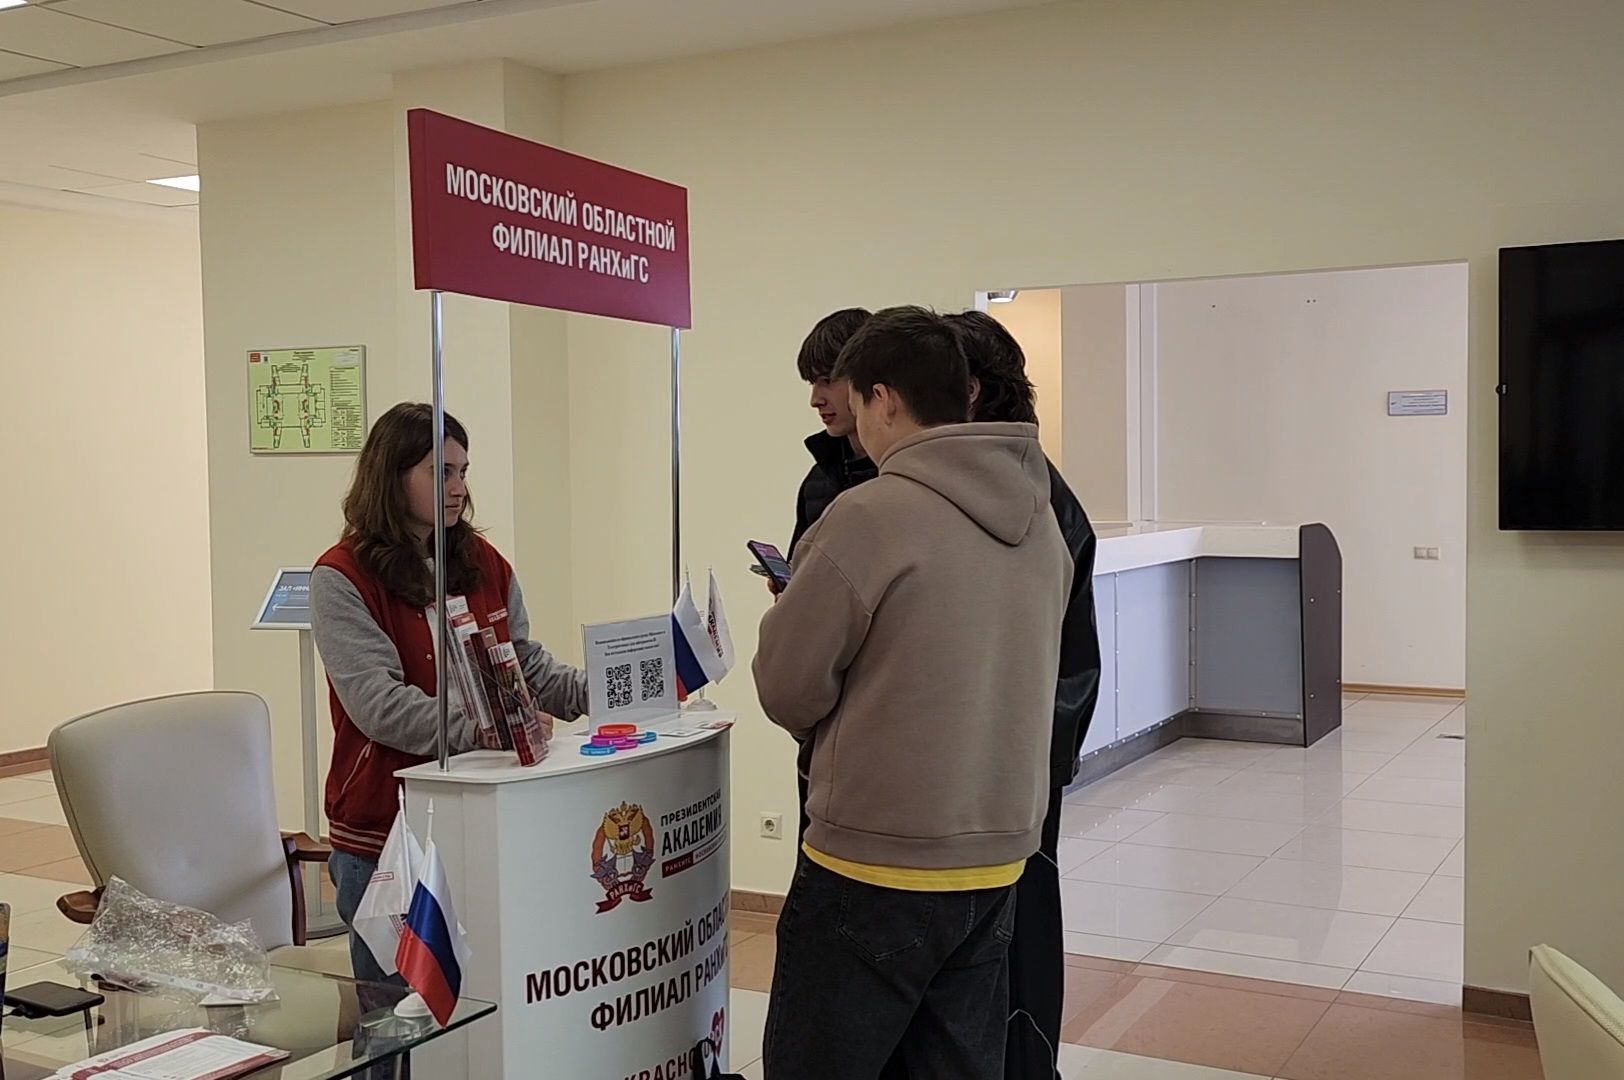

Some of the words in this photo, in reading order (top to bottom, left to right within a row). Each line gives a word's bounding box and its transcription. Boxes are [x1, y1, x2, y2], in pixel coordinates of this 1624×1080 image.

[446, 163, 577, 227] МОСКОВСКИЙ
[582, 202, 676, 252] ОБЛАСТНОЙ
[492, 222, 573, 267] ФИЛИАЛ
[578, 242, 649, 283] РАНХиГС
[661, 804, 722, 856] АКАДЕМИЯ
[526, 919, 694, 1004] МОСКОВСКИЙ
[590, 970, 691, 1031] ФИЛИАЛ
